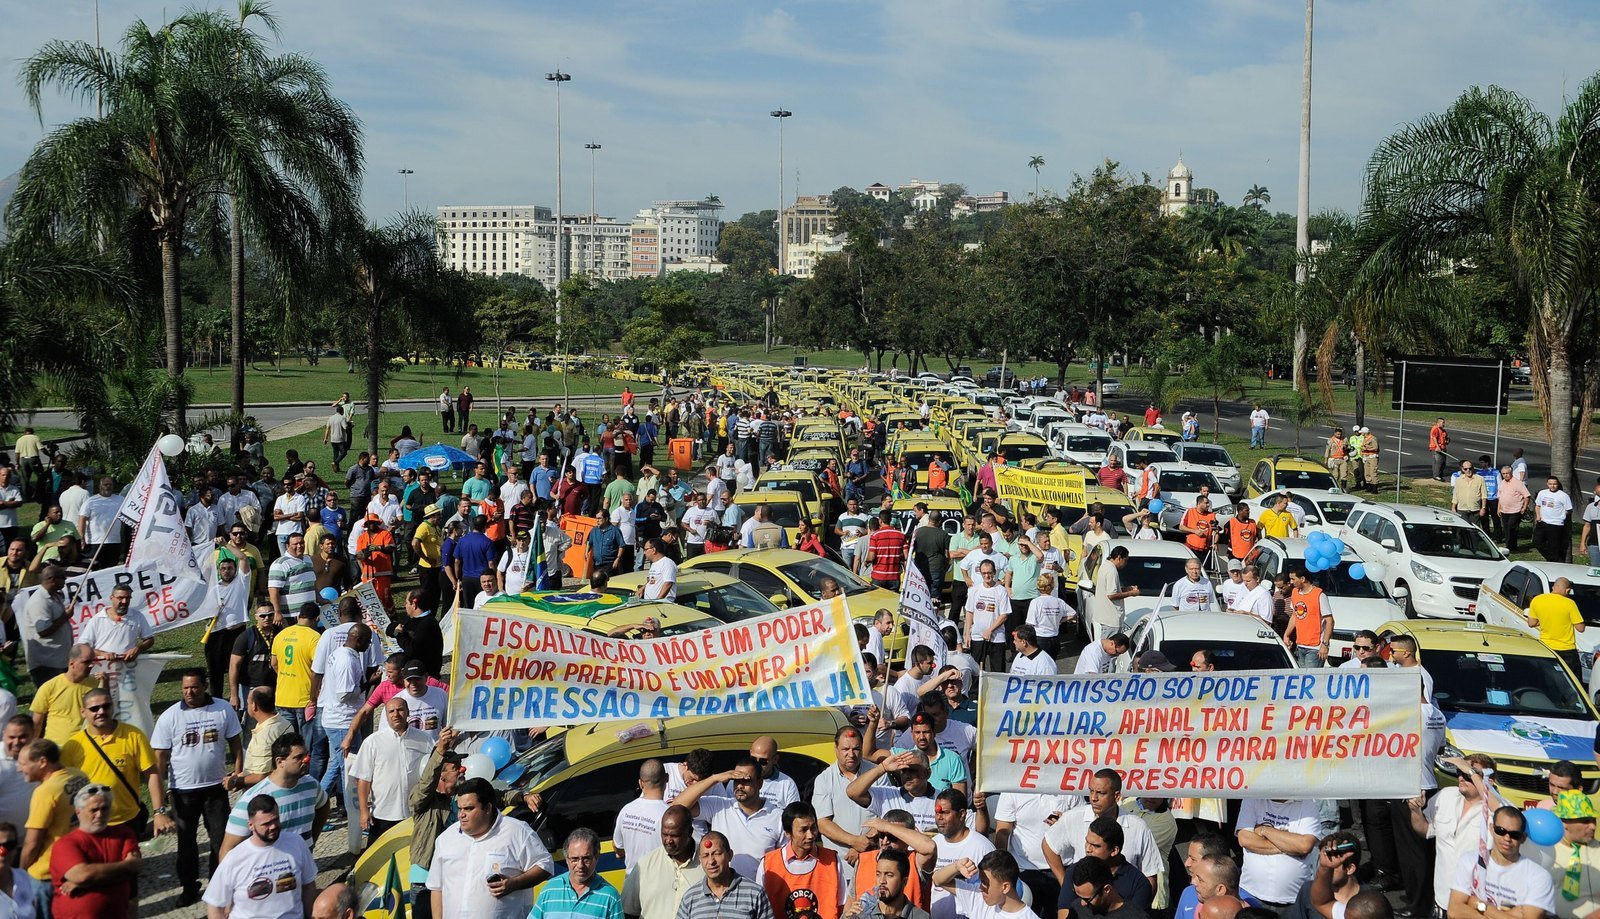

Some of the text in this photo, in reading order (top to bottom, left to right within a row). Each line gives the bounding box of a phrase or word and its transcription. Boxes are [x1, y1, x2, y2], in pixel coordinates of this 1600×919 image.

[999, 484, 1024, 497] LIBERA
[1032, 488, 1040, 499] AS
[145, 586, 175, 609] DE
[148, 601, 191, 627] TOS
[482, 608, 832, 667] FISCALIZAÇÃO NÃO É UM PODER,
[1259, 630, 1275, 638] TAXI
[284, 644, 294, 666] 9
[464, 652, 557, 682] SENHOR
[562, 663, 662, 693] PREFEITO
[670, 668, 682, 692] É
[682, 669, 721, 692] UM
[722, 655, 787, 690] DEVER
[470, 661, 868, 721] REPRESSÃO A PIRATARIA JÁ!
[1001, 674, 1370, 705] PERMISSÃO SÓ PODE TER UM
[995, 709, 1115, 738] AUXILIAR,
[1118, 706, 1197, 735] AFINAL
[1288, 705, 1371, 731] PARA
[1008, 732, 1420, 765] TAXISTA E NÃO PARA INVESTIDOR
[1019, 766, 1041, 789] E
[624, 812, 656, 825] Taxistas Unidos
[638, 822, 656, 832] Pirataria
[789, 889, 814, 901] FORÇA
